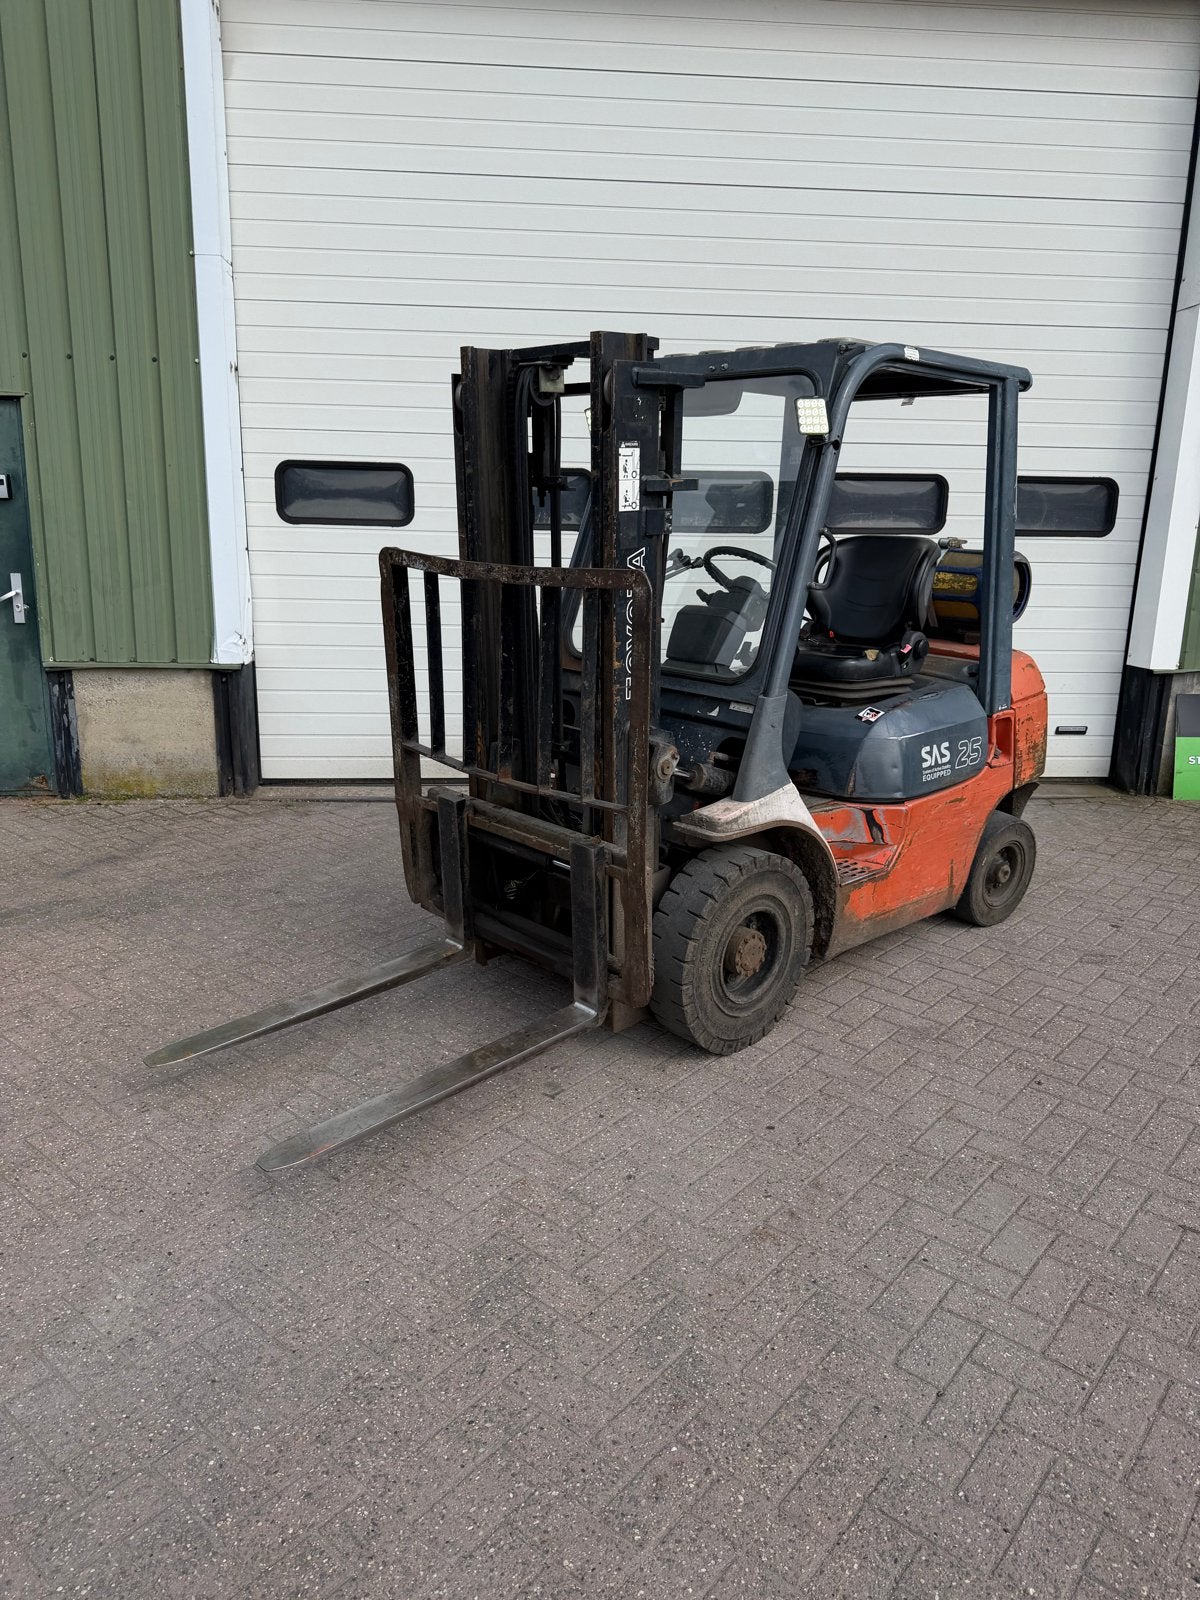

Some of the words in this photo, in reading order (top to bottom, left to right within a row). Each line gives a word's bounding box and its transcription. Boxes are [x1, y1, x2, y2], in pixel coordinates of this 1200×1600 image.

[921, 741, 950, 768] SAS
[955, 736, 982, 769] 25
[922, 769, 952, 782] EQUIPPED
